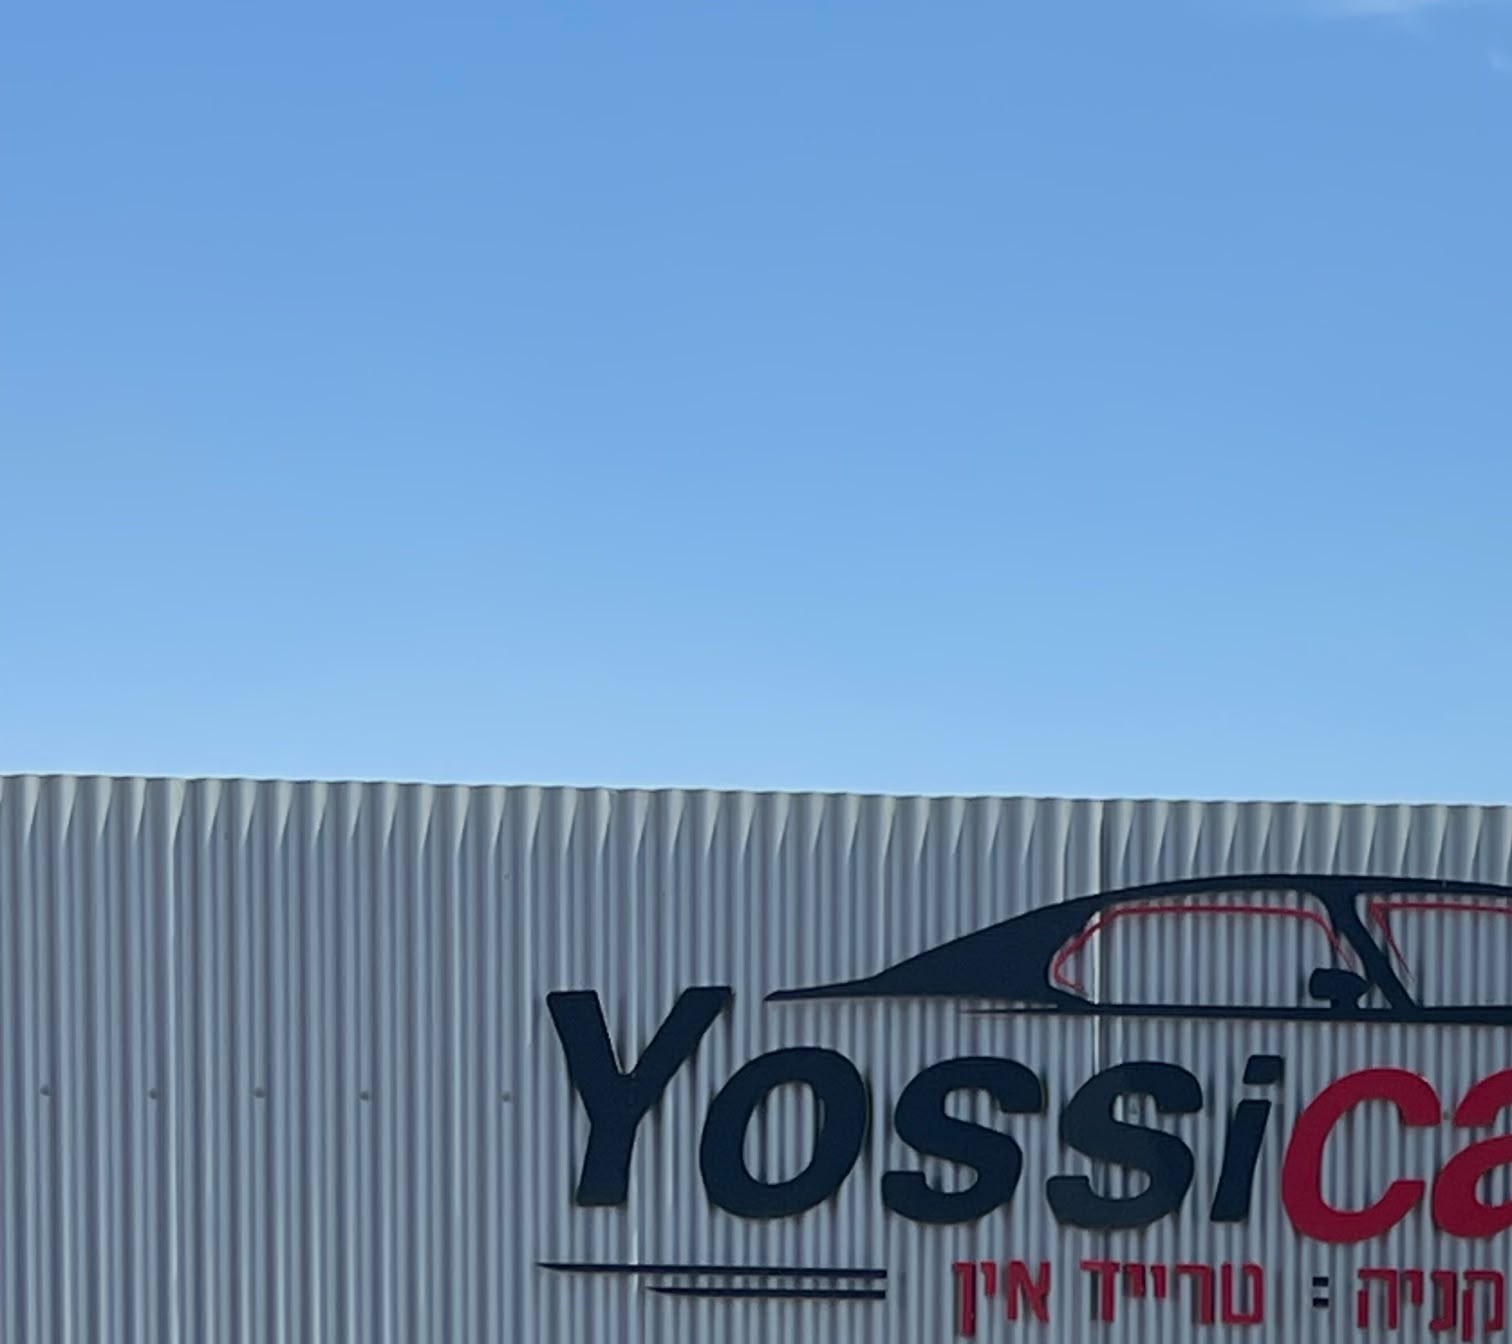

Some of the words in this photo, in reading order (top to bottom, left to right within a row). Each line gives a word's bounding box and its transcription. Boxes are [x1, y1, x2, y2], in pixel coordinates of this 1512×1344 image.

[953, 1259, 1051, 1338] אין
[1080, 1258, 1266, 1326] טרייד
[1356, 1266, 1505, 1342] קניה
